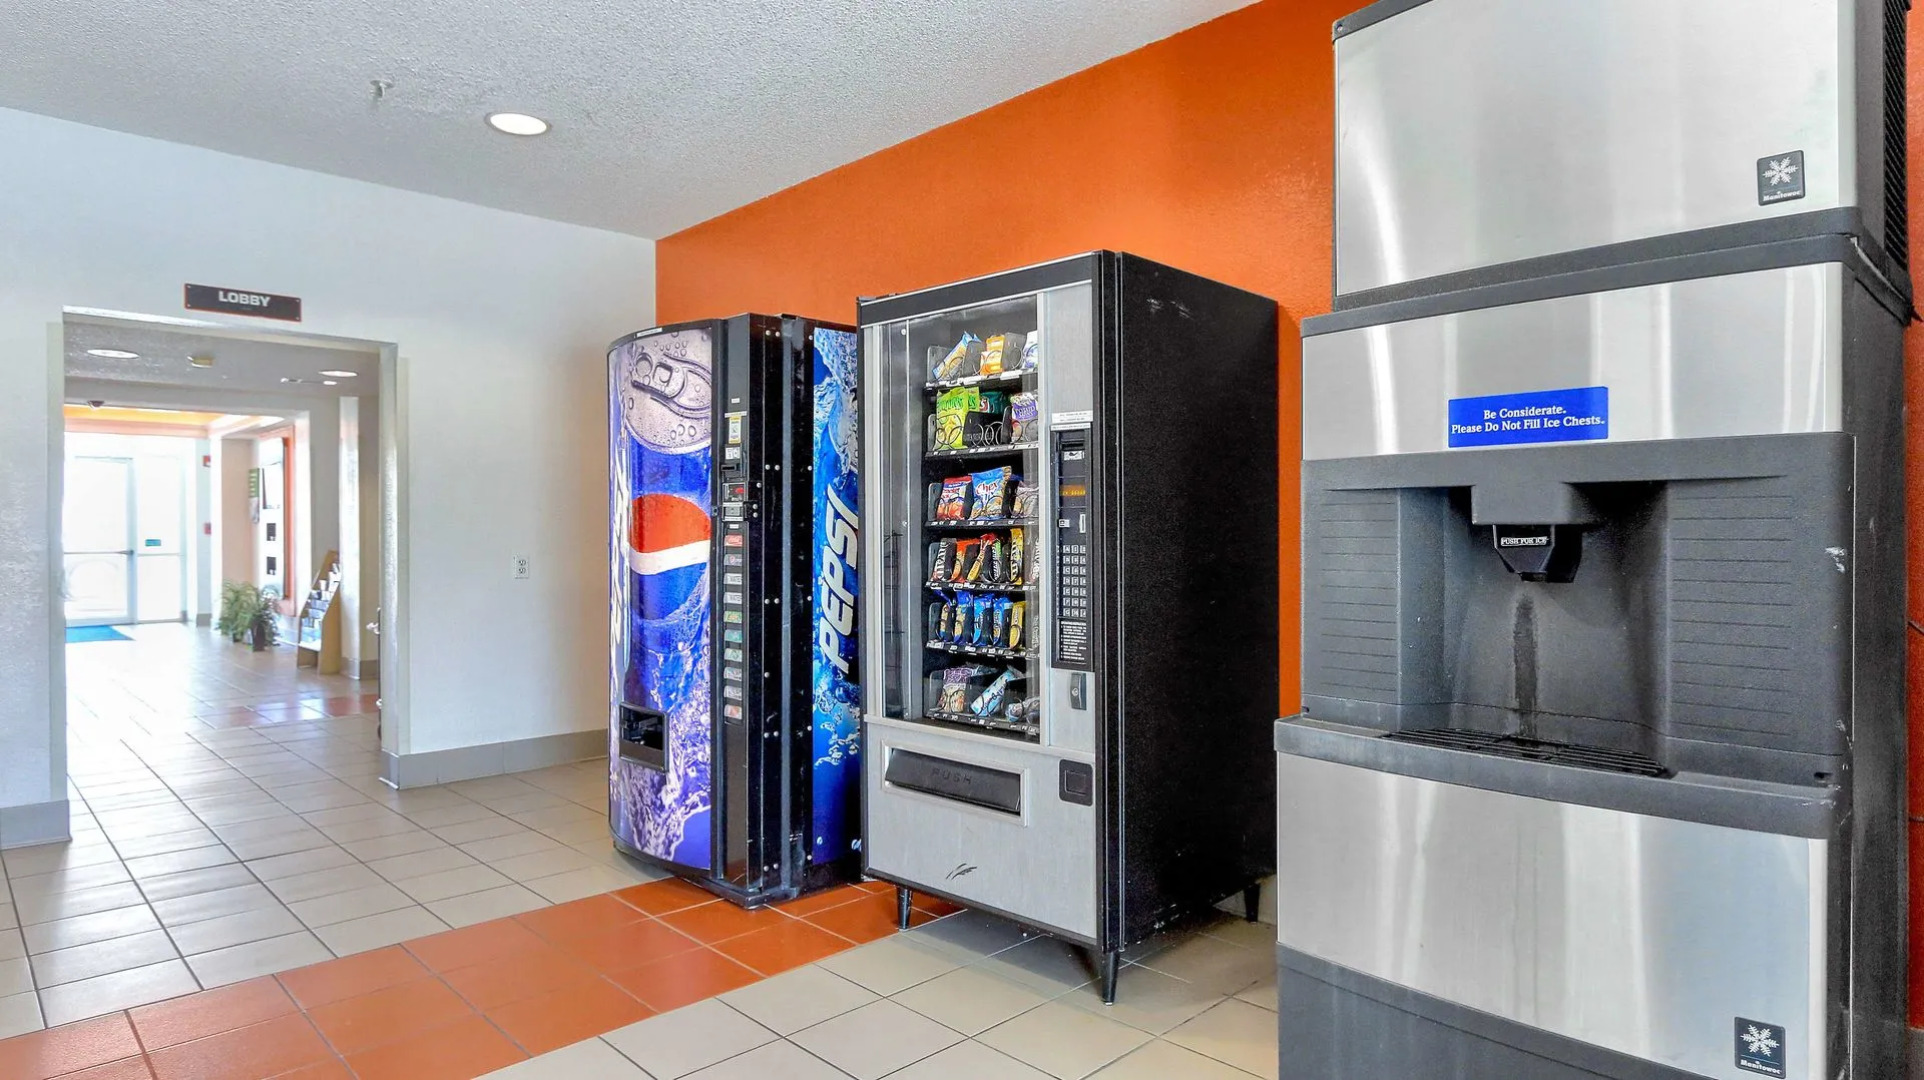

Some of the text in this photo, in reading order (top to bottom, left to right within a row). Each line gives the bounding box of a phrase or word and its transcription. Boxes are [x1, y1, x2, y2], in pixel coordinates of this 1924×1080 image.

[218, 290, 271, 307] LOBBY
[1483, 405, 1566, 420] Be Considerate.
[1451, 415, 1605, 434] Please Do Not Fill Ice Chests.
[818, 483, 859, 675] PEPSI
[932, 767, 972, 785] PUSH
